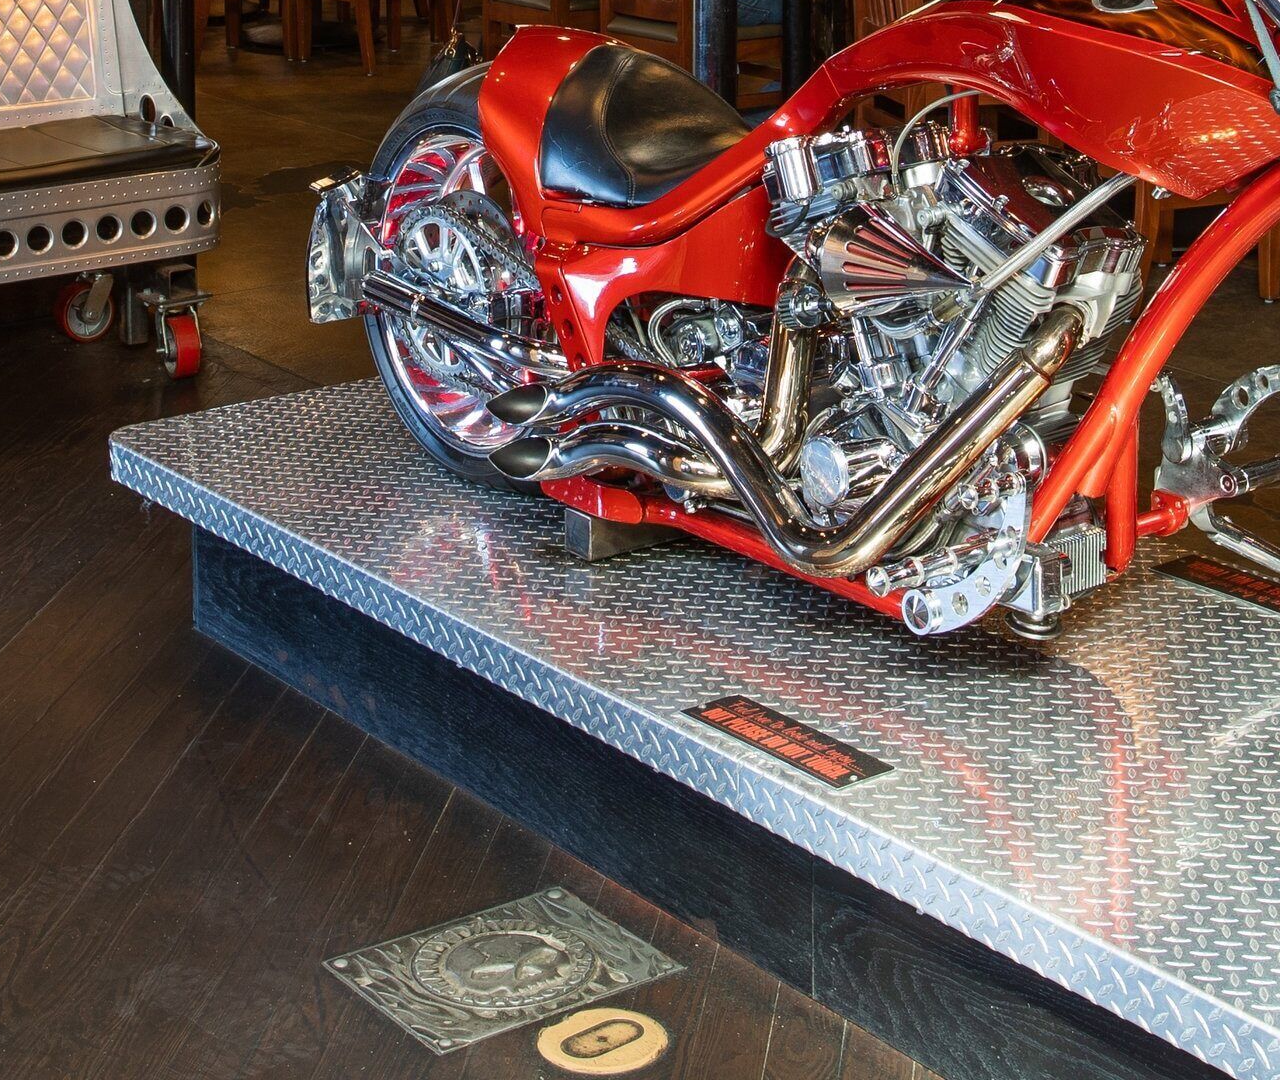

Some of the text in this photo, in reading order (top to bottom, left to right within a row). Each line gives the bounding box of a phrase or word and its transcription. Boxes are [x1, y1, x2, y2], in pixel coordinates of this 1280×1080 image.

[698, 707, 737, 722] BUT
[719, 717, 774, 740] PLEASE
[756, 735, 791, 748] DO
[773, 743, 814, 759] NOT
